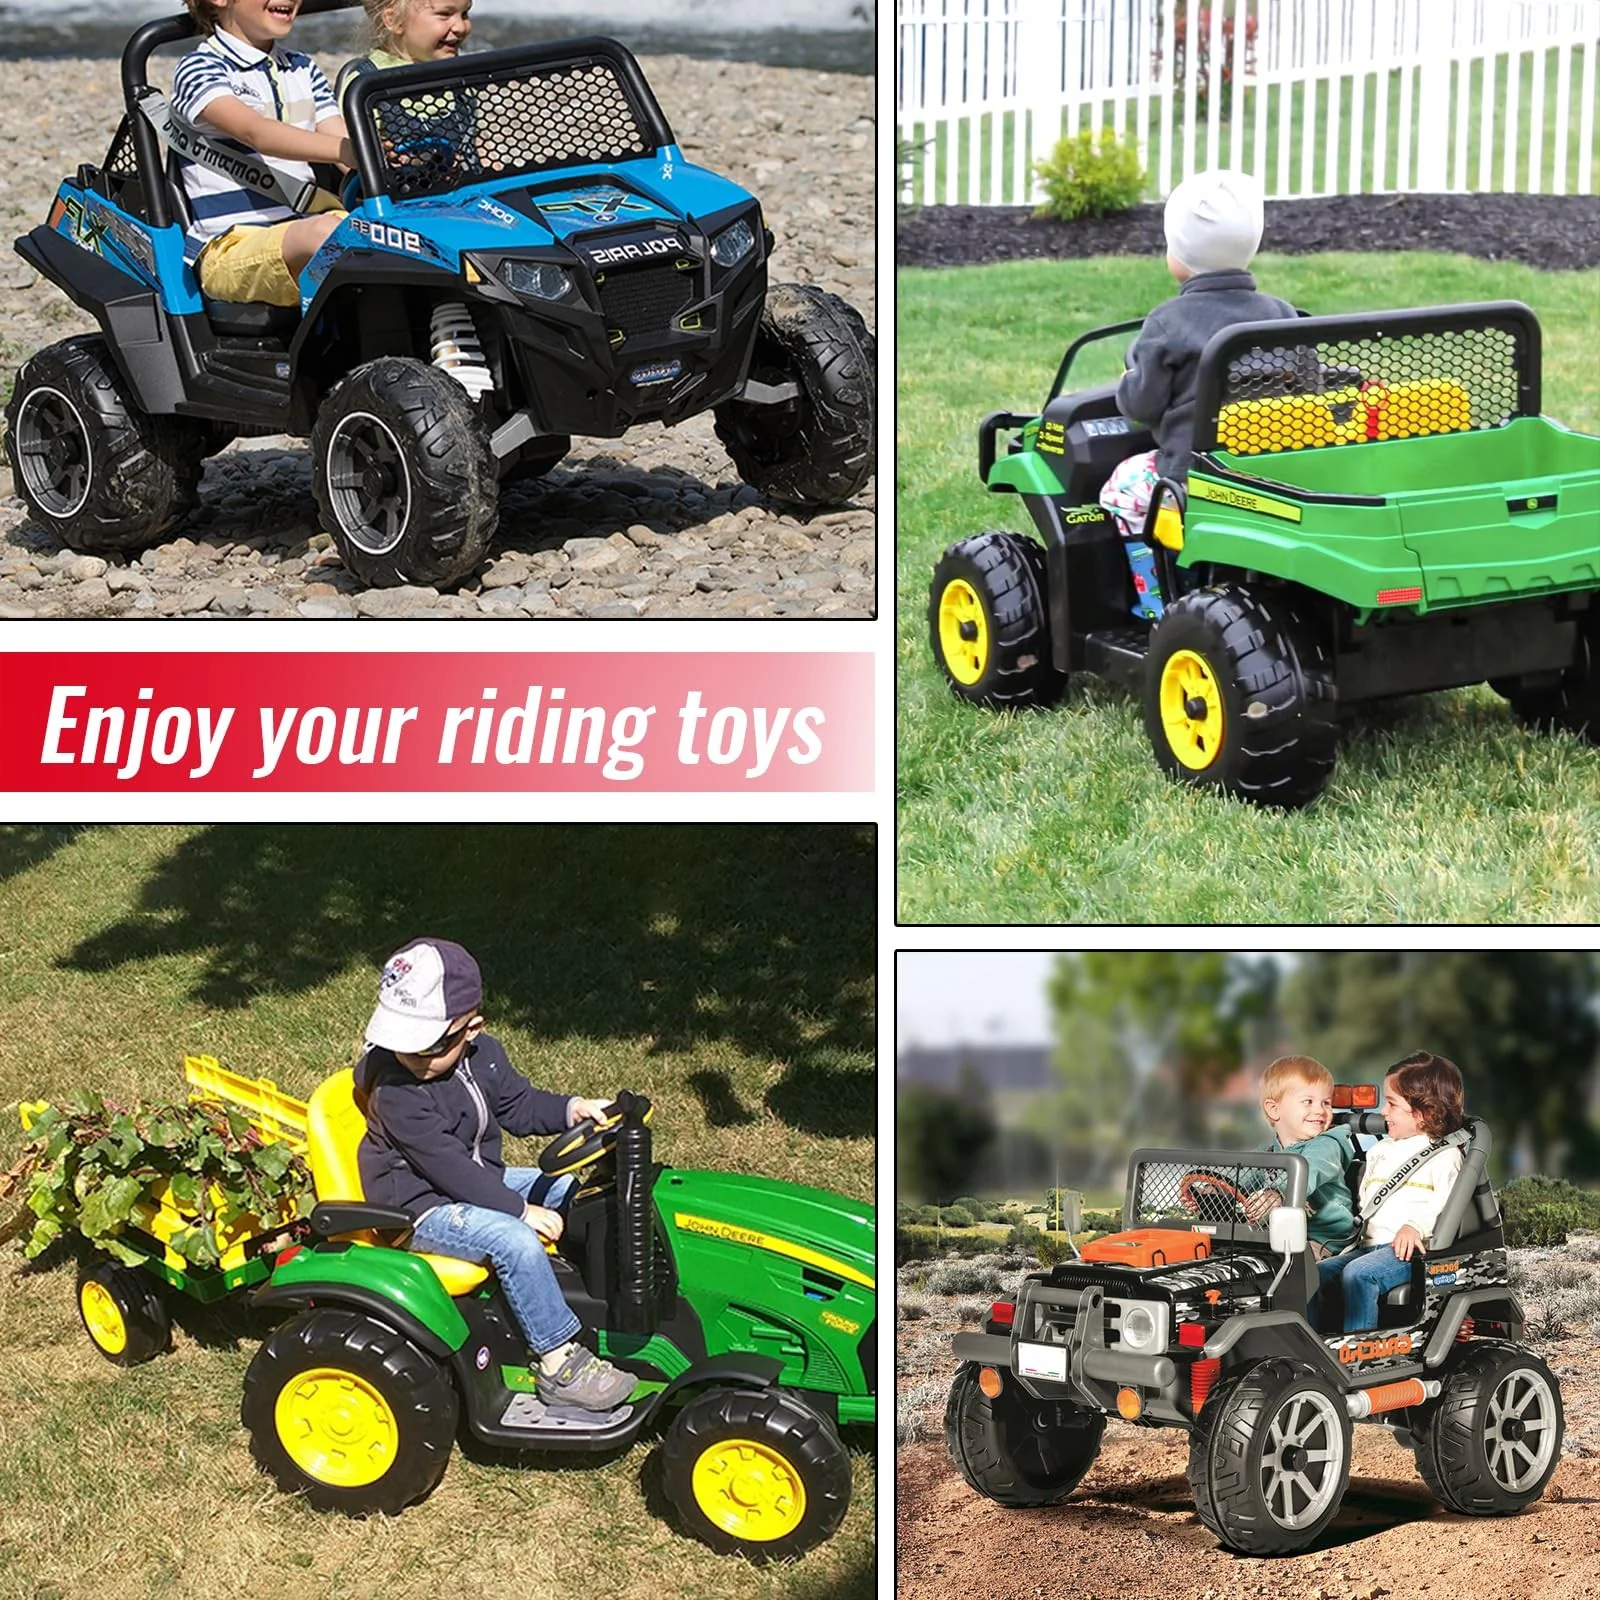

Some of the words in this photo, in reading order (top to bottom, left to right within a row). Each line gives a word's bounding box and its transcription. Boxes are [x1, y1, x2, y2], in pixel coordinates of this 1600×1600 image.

[1206, 487, 1228, 502] JOHN
[1229, 491, 1257, 508] DEERE
[1066, 512, 1105, 524] GATOR
[684, 1219, 719, 1234] JOHN
[721, 1226, 764, 1245] DEERE
